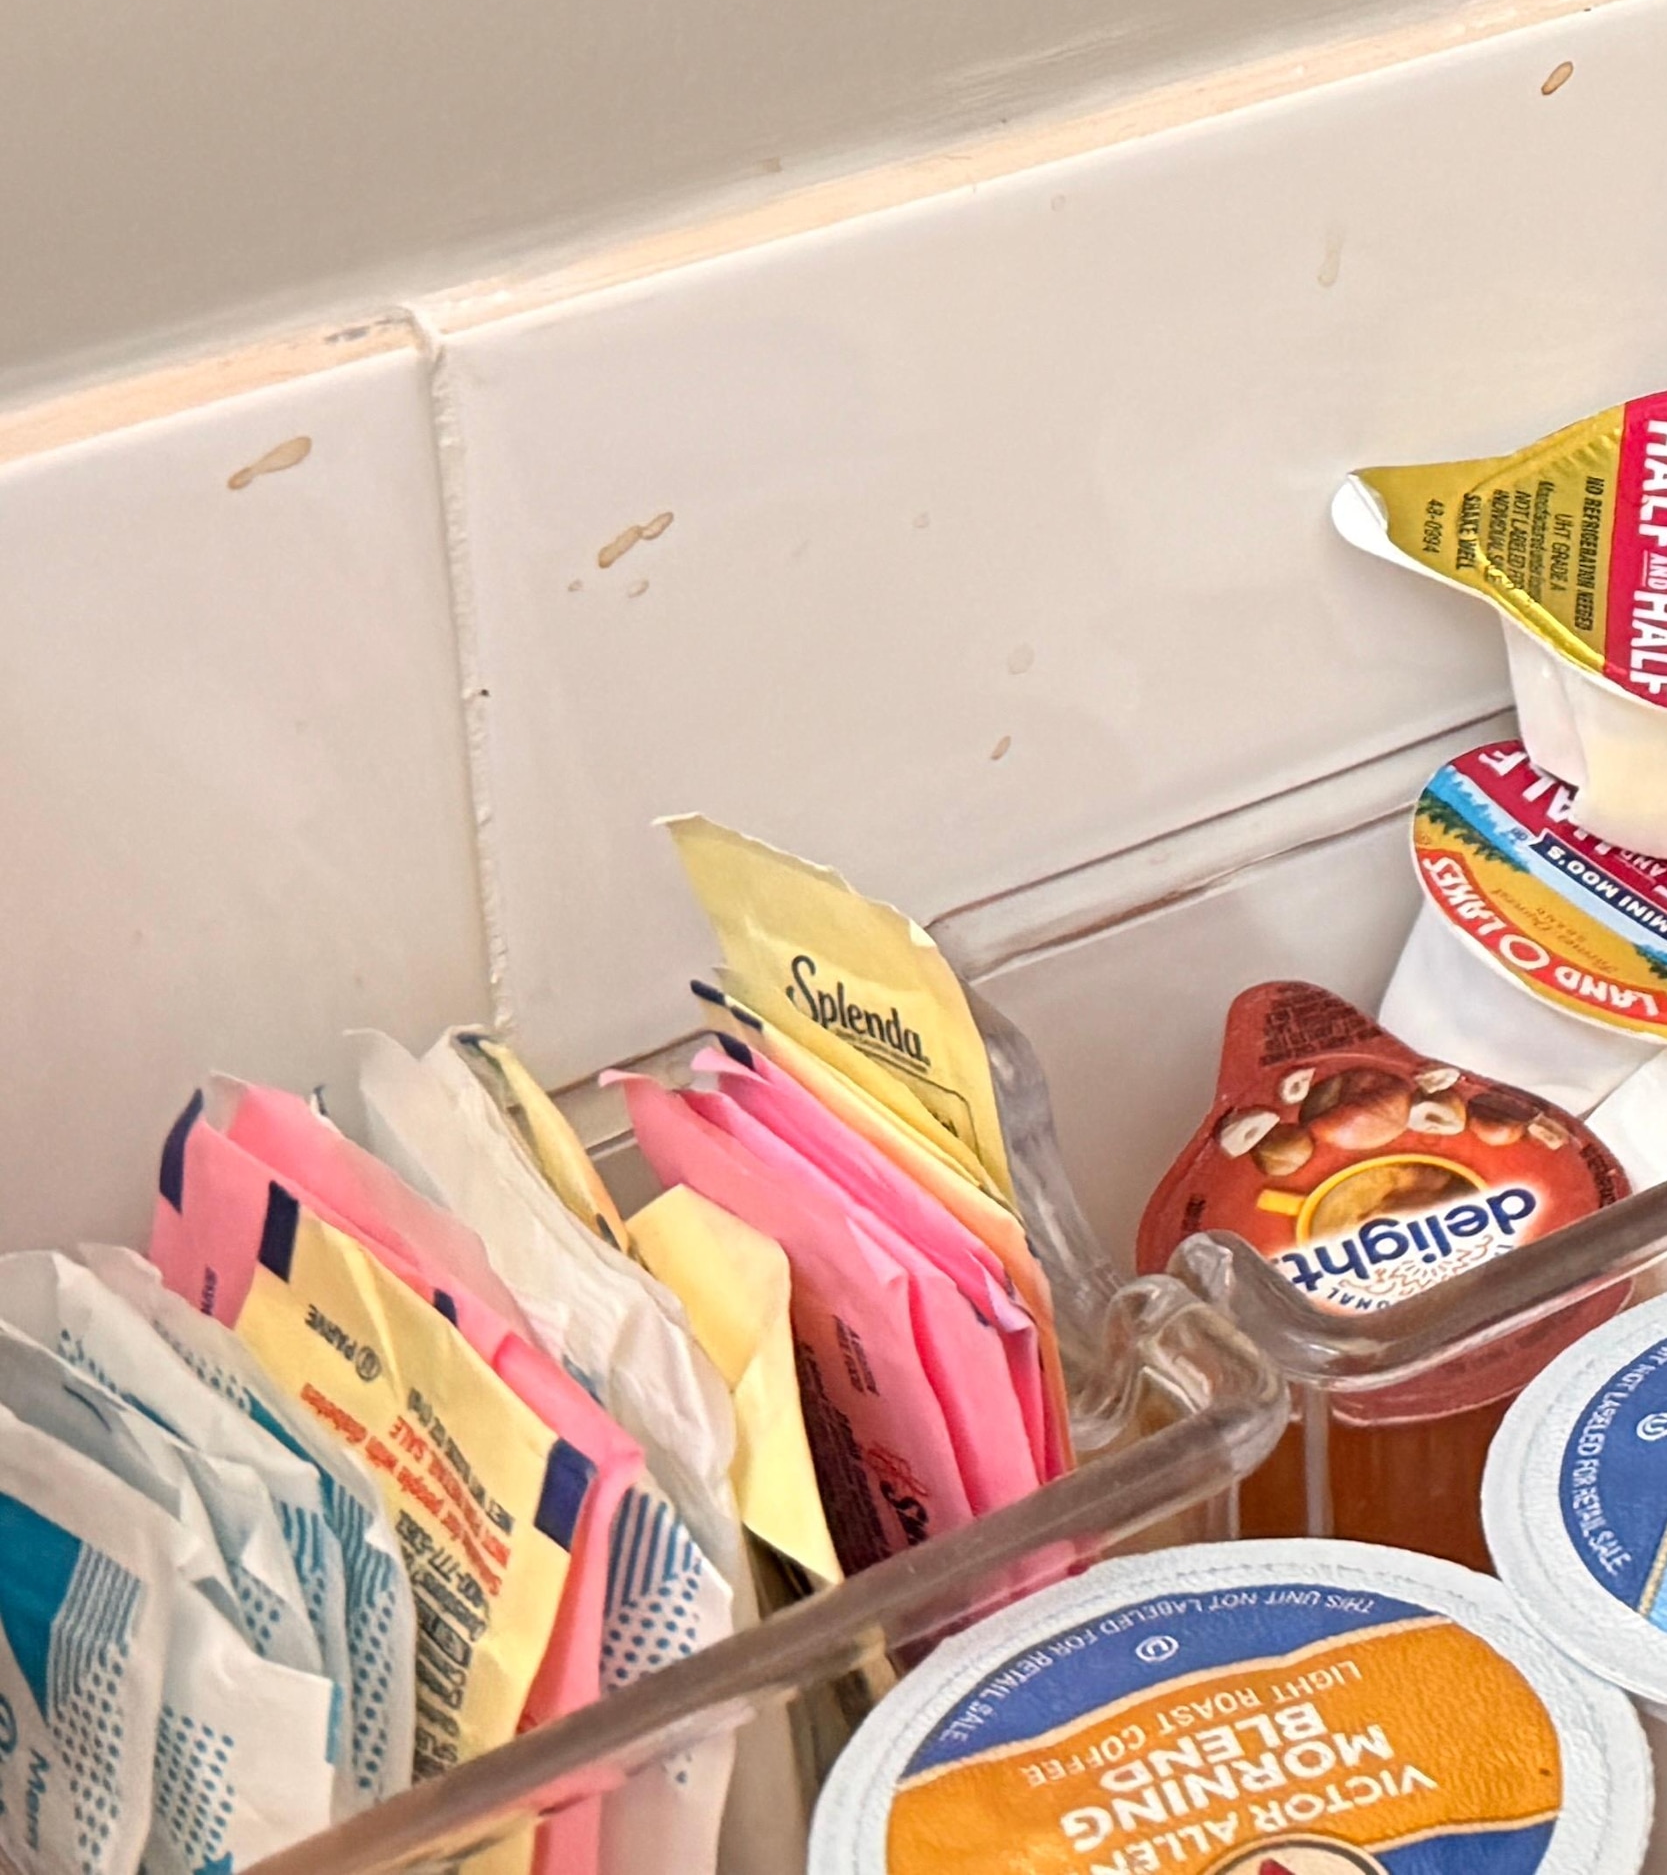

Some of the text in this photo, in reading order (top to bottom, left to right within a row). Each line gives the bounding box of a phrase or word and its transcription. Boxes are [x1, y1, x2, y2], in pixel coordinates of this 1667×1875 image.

[1421, 856, 1507, 936] LAKES
[1547, 845, 1620, 899] MOO'S
[785, 954, 926, 1062] Splenda
[1554, 966, 1659, 1017] LAND
[1282, 1188, 1537, 1292] delight
[1100, 1597, 1206, 1637] LABELED
[1208, 1591, 1258, 1613] NOT
[1265, 1589, 1320, 1607] UNIT
[1327, 1593, 1376, 1615] THIS
[1048, 1631, 1099, 1662] FOR
[981, 1648, 1053, 1700] RETAIL
[1020, 1660, 1363, 1789] LIGHT ROAST COFFEE
[1100, 1701, 1328, 1792] BLEND
[1059, 1724, 1395, 1853] MORNING
[1248, 1764, 1438, 1833] VICTOR
